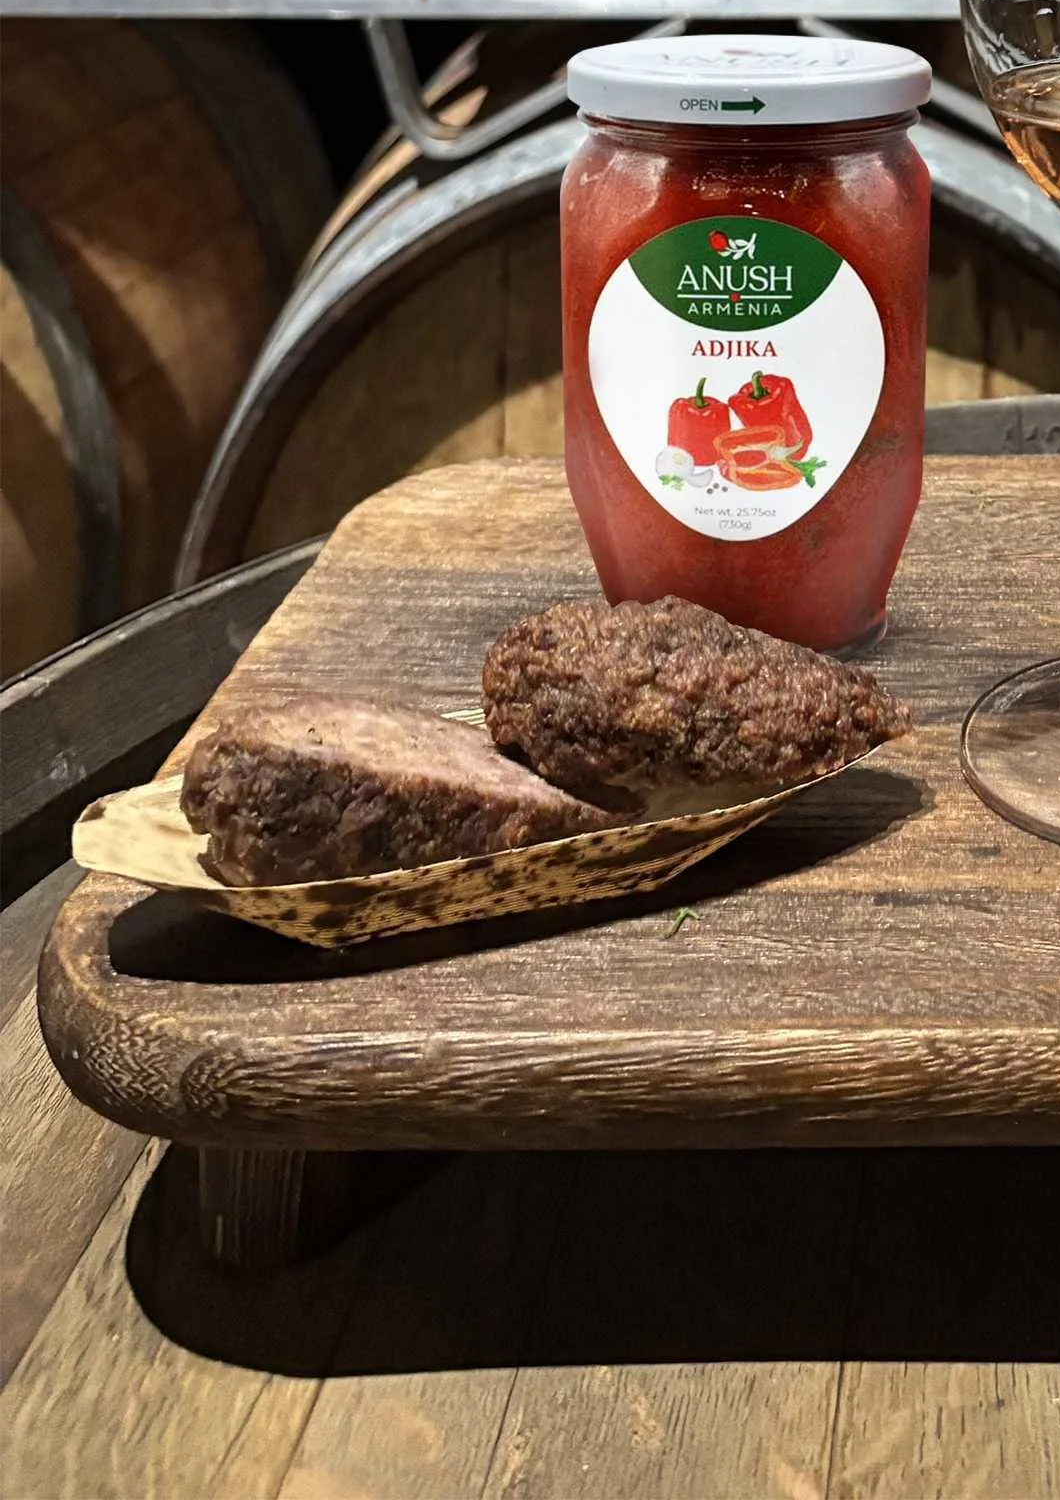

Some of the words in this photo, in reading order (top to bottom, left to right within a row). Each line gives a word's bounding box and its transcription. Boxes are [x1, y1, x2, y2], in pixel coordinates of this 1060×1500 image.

[679, 99, 719, 112] OPEN
[676, 264, 793, 292] ANUSH
[687, 302, 783, 316] ARMENIA
[692, 339, 778, 359] ADJIKA
[694, 506, 714, 516] Net
